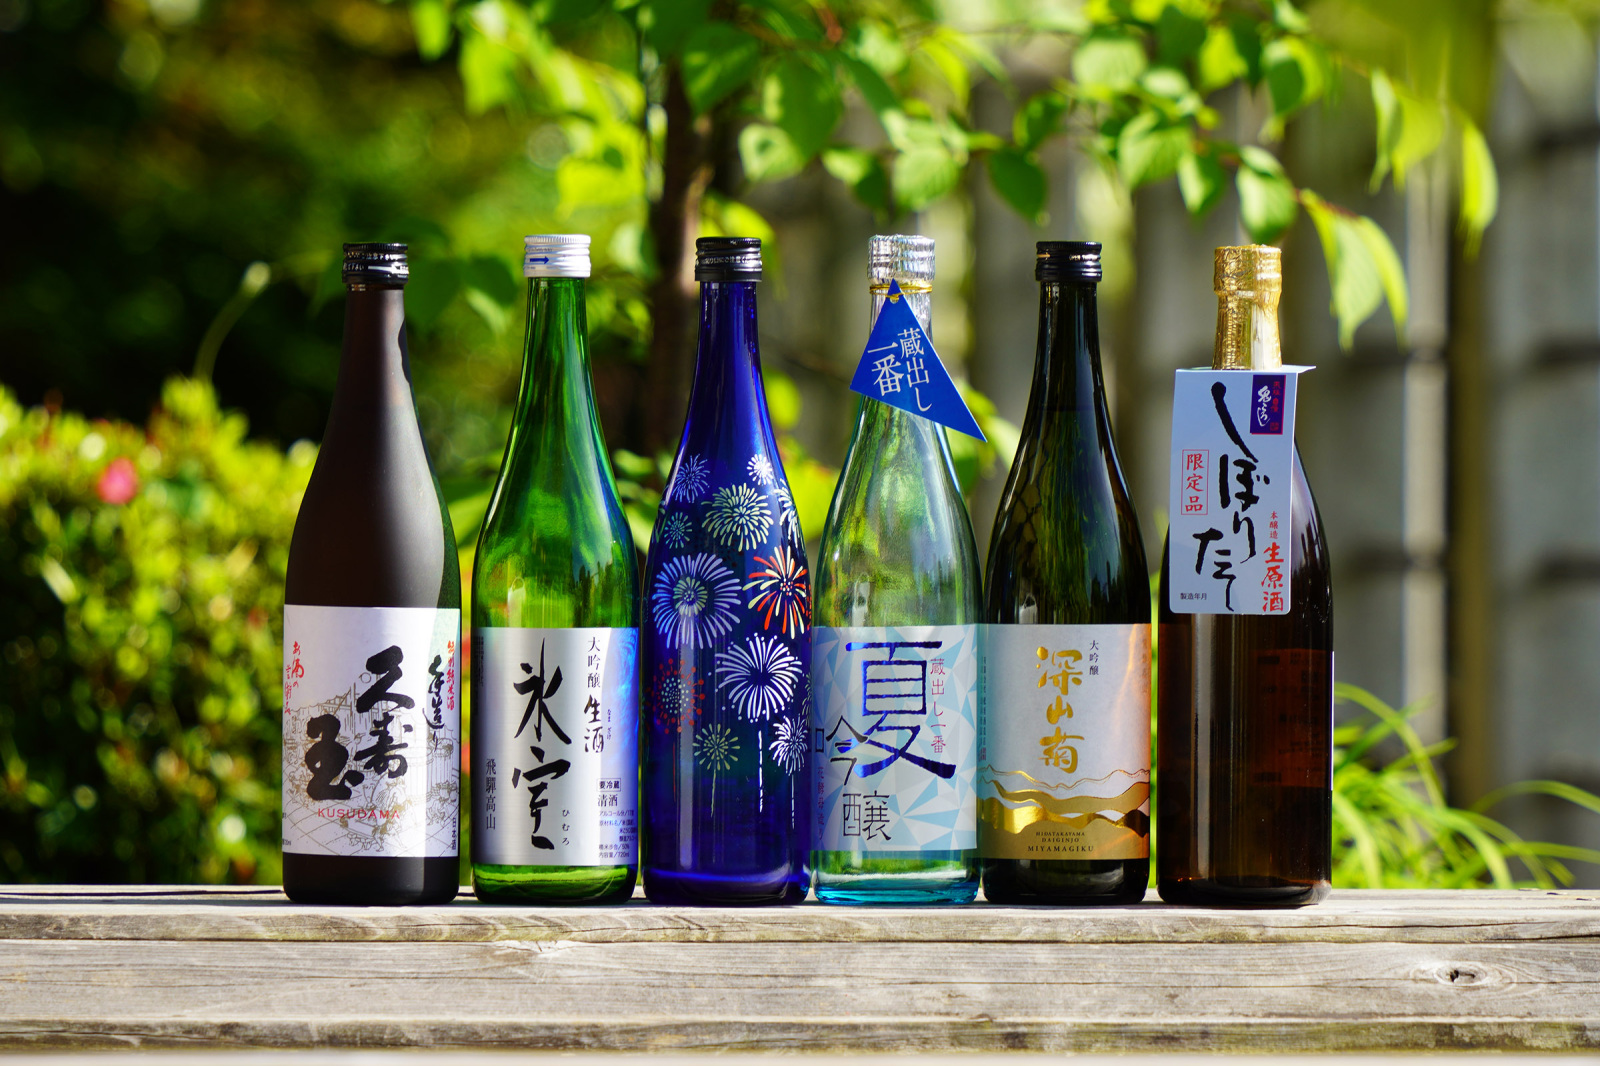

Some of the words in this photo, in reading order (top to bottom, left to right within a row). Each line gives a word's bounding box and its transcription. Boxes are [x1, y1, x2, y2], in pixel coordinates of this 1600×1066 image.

[867, 342, 905, 396] 一番
[897, 328, 932, 412] 蔵出し
[1185, 453, 1204, 512] 限定品
[1269, 511, 1278, 539] 本醸造
[1261, 542, 1284, 612] 生原酒
[587, 636, 601, 688] 大吟醸
[1089, 639, 1099, 675] 大吟醸
[584, 694, 604, 753] 生酒
[930, 658, 946, 753] 蔵出し一番
[1036, 646, 1084, 774] 深山菊
[512, 637, 572, 850] 氷室
[597, 794, 618, 807] 清酒
[600, 781, 620, 789] 要冷蔵
[317, 808, 400, 819] KUSUDAMA
[562, 809, 570, 845] ひむろ
